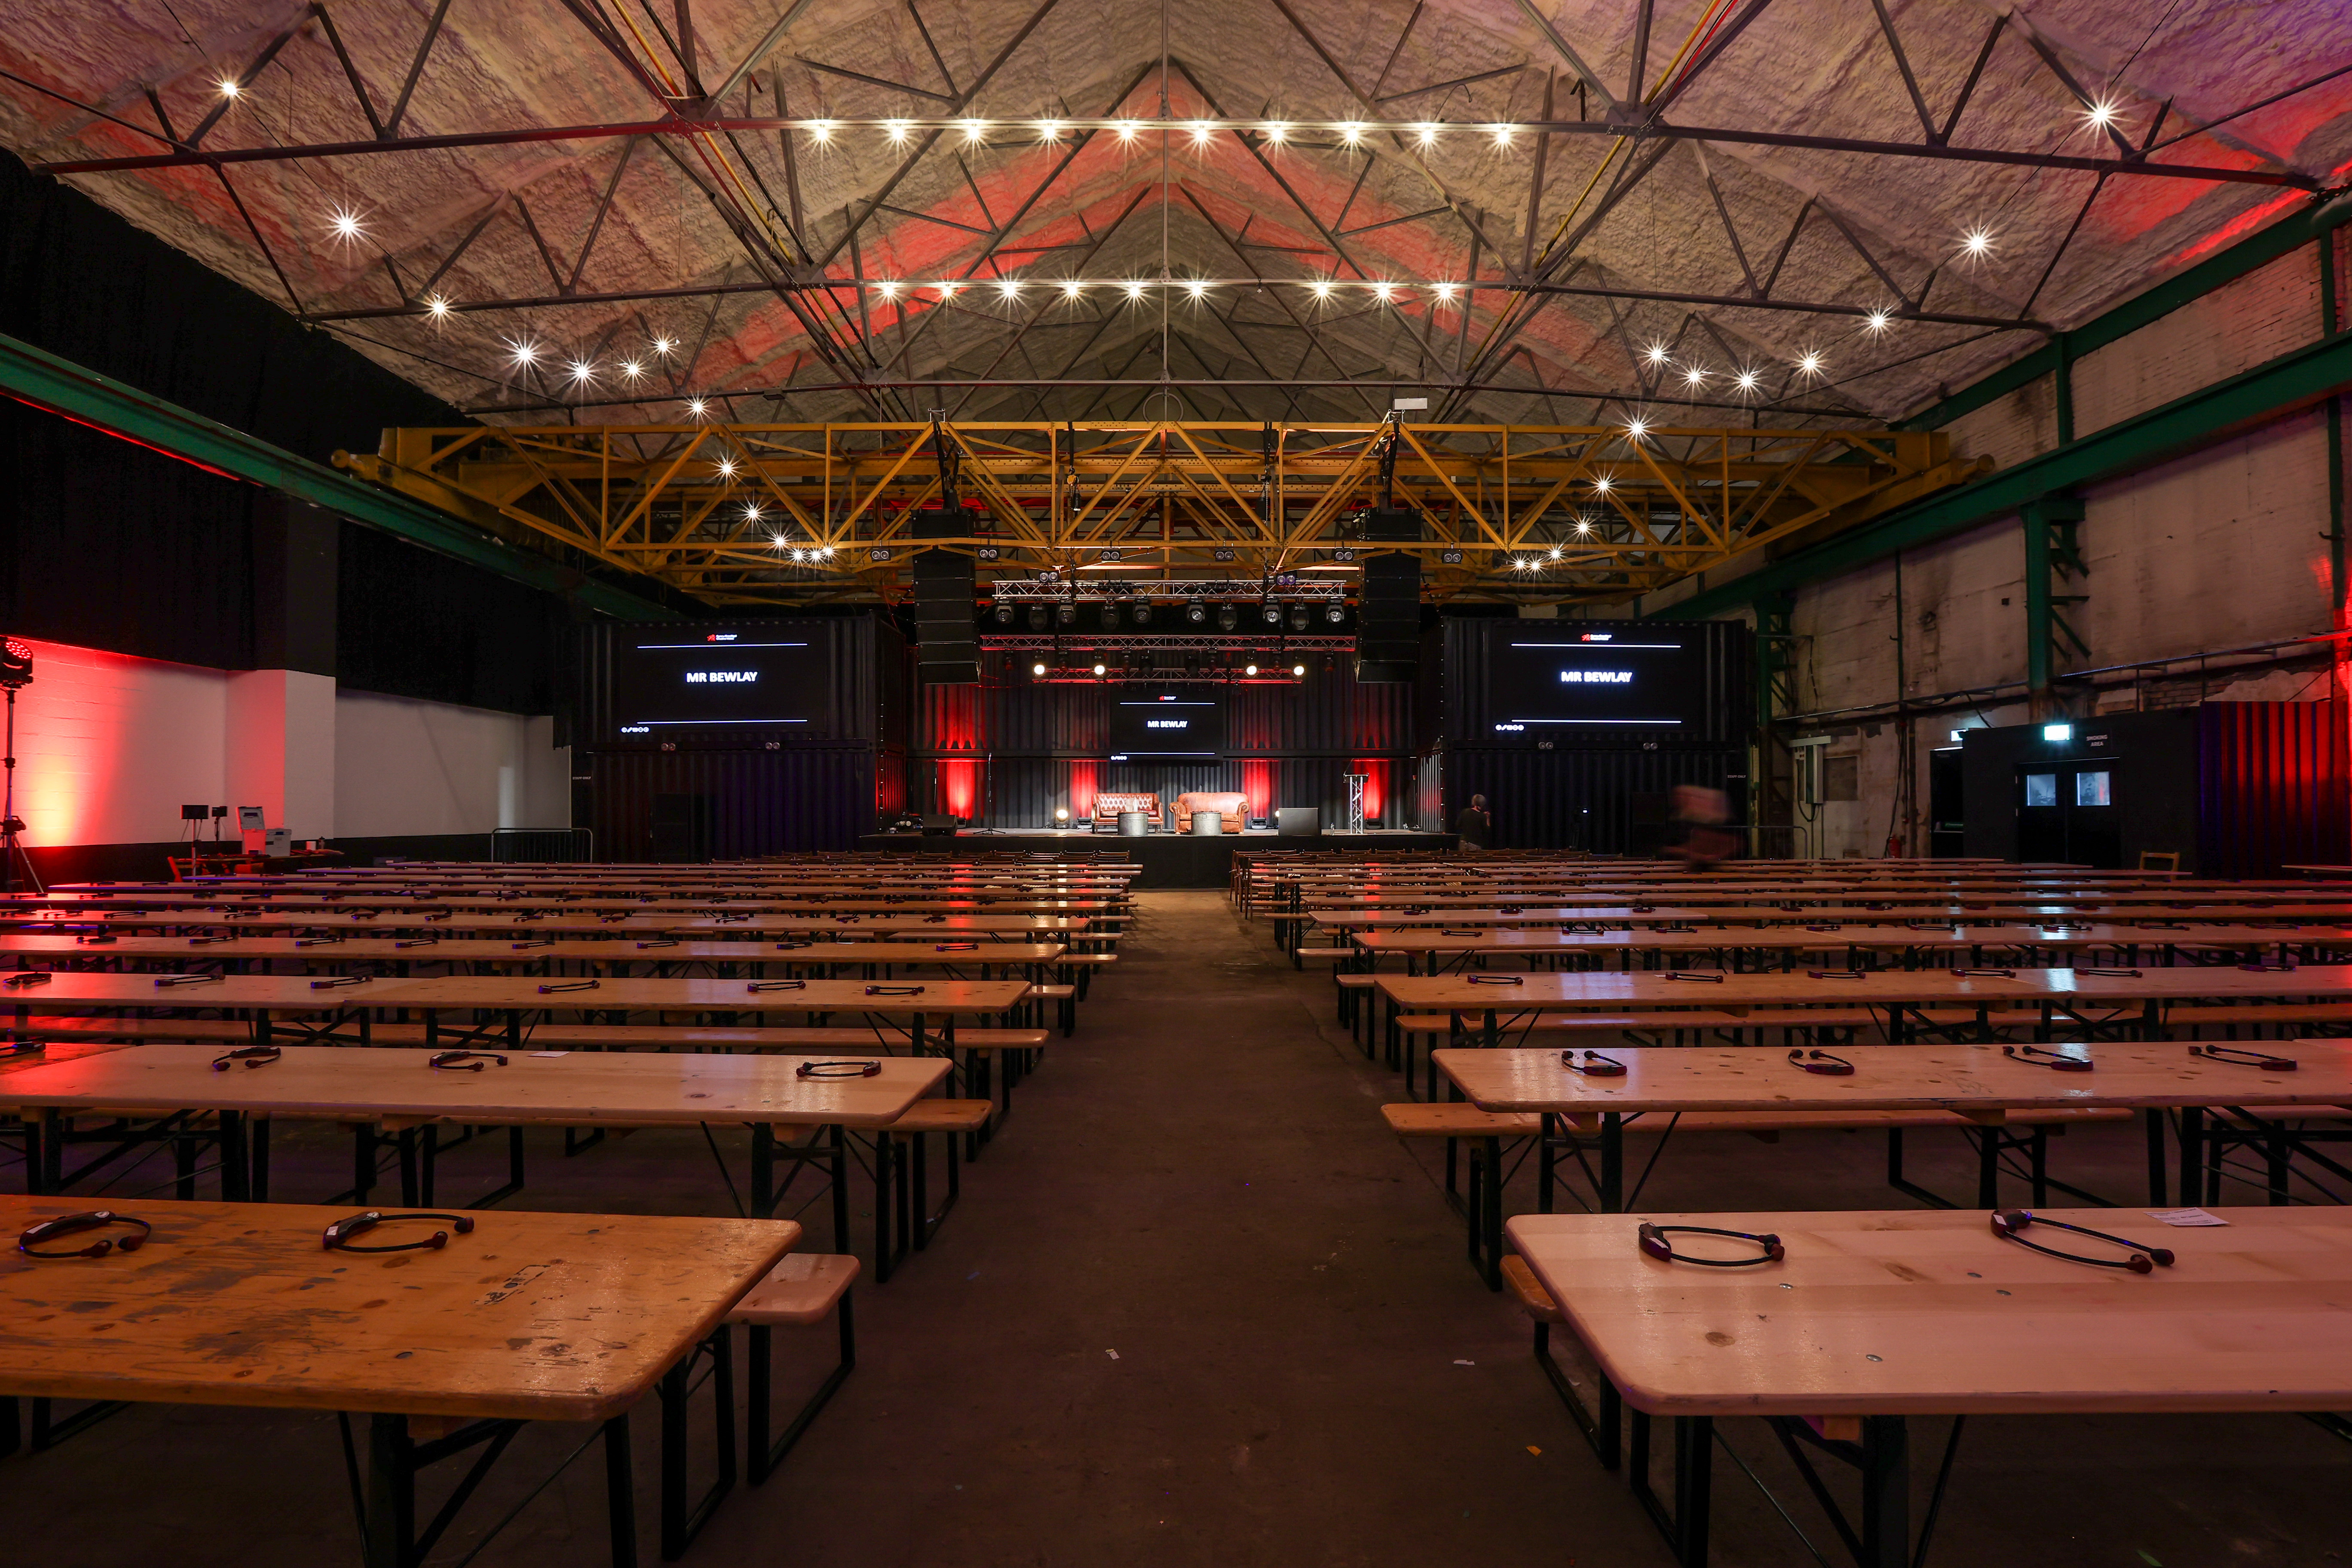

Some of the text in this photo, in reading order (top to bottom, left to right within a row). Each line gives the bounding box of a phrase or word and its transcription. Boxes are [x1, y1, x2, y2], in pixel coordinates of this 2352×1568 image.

[686, 671, 758, 683] MR BEWLAY
[1561, 671, 1632, 683] MR BEWLAY
